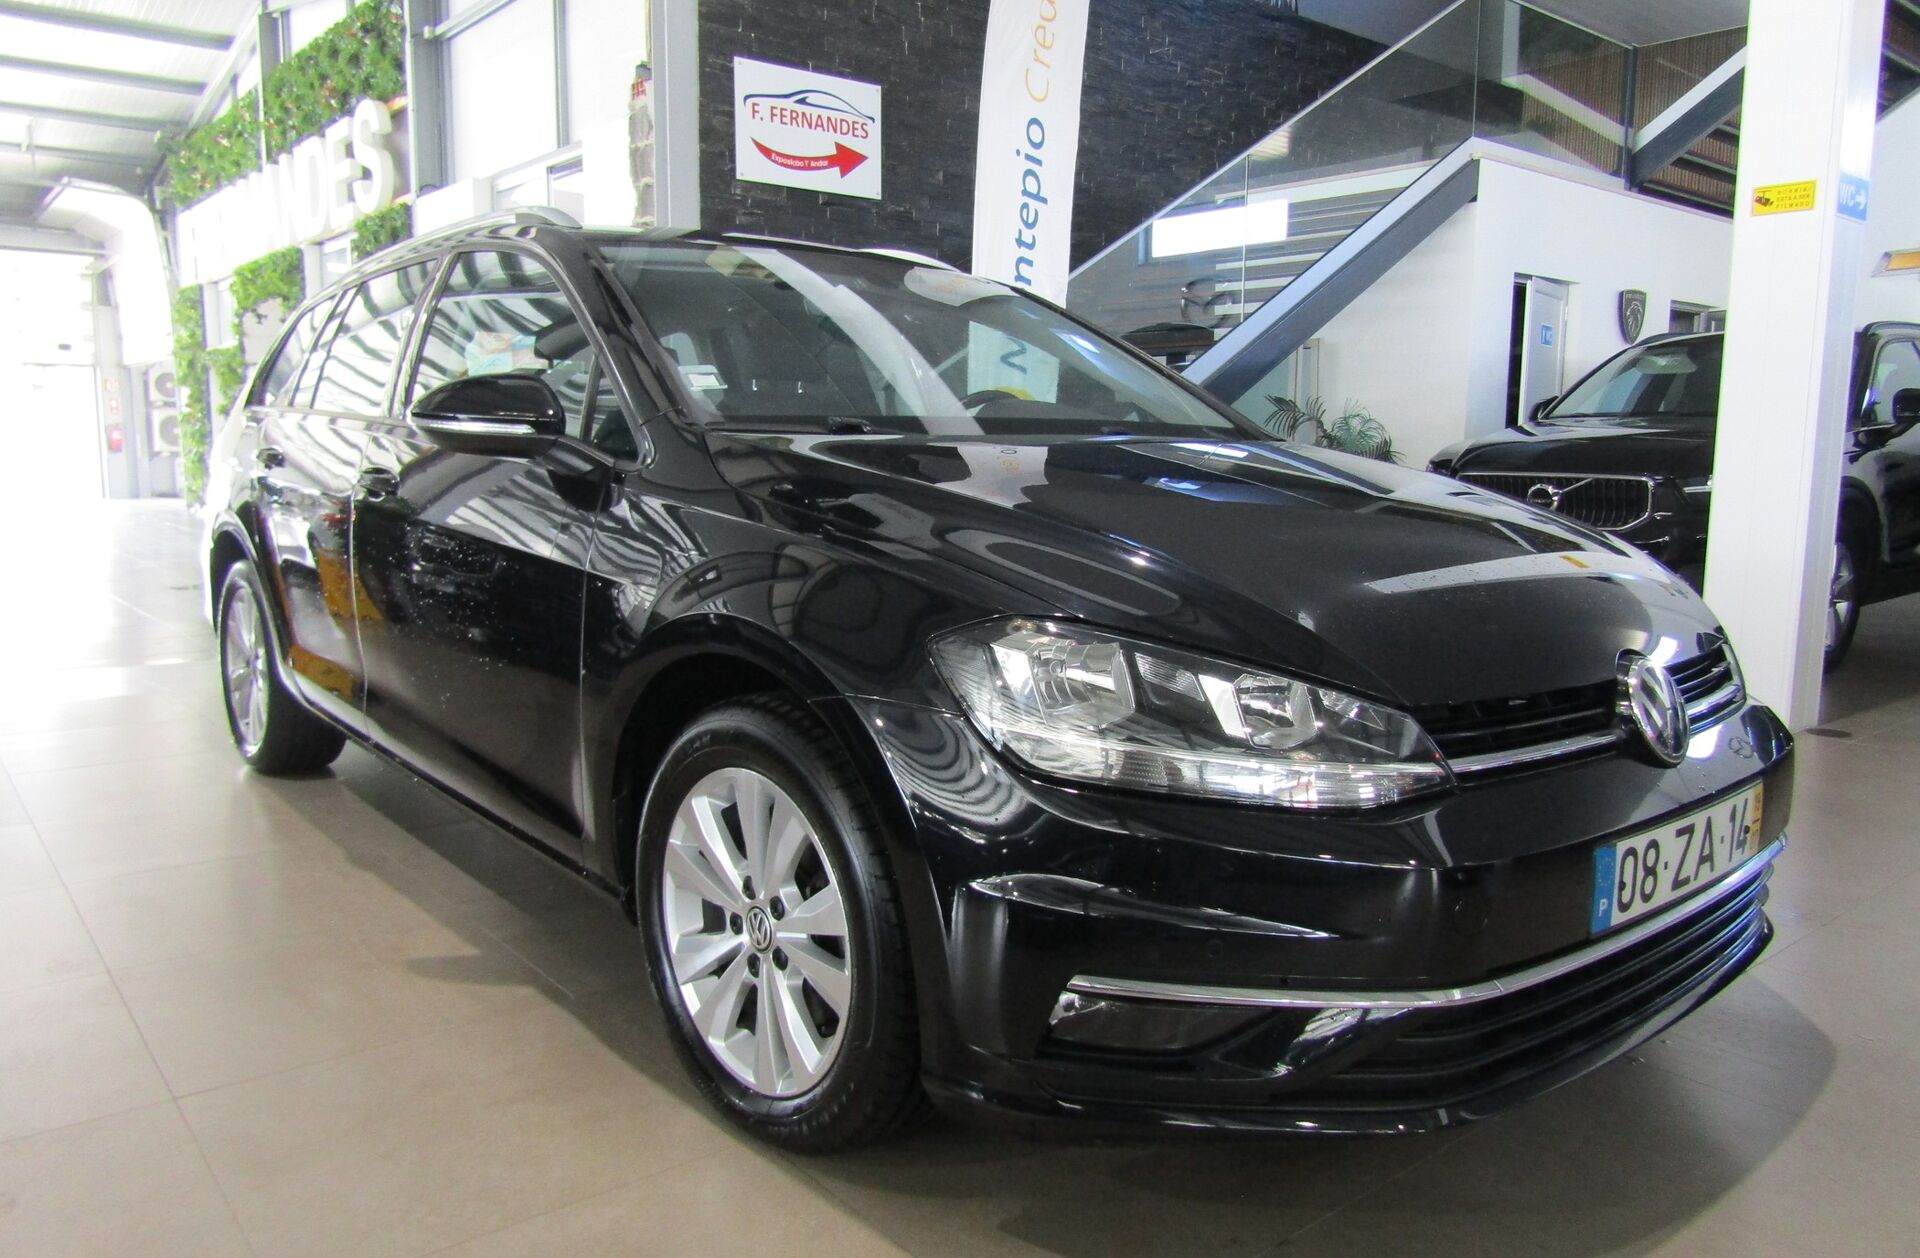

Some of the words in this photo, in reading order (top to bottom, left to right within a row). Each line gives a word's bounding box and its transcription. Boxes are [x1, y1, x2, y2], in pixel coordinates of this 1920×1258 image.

[752, 102, 764, 121] F.
[770, 106, 869, 140] FERNANDES
[1840, 182, 1857, 208] WC
[1598, 898, 1608, 917] P
